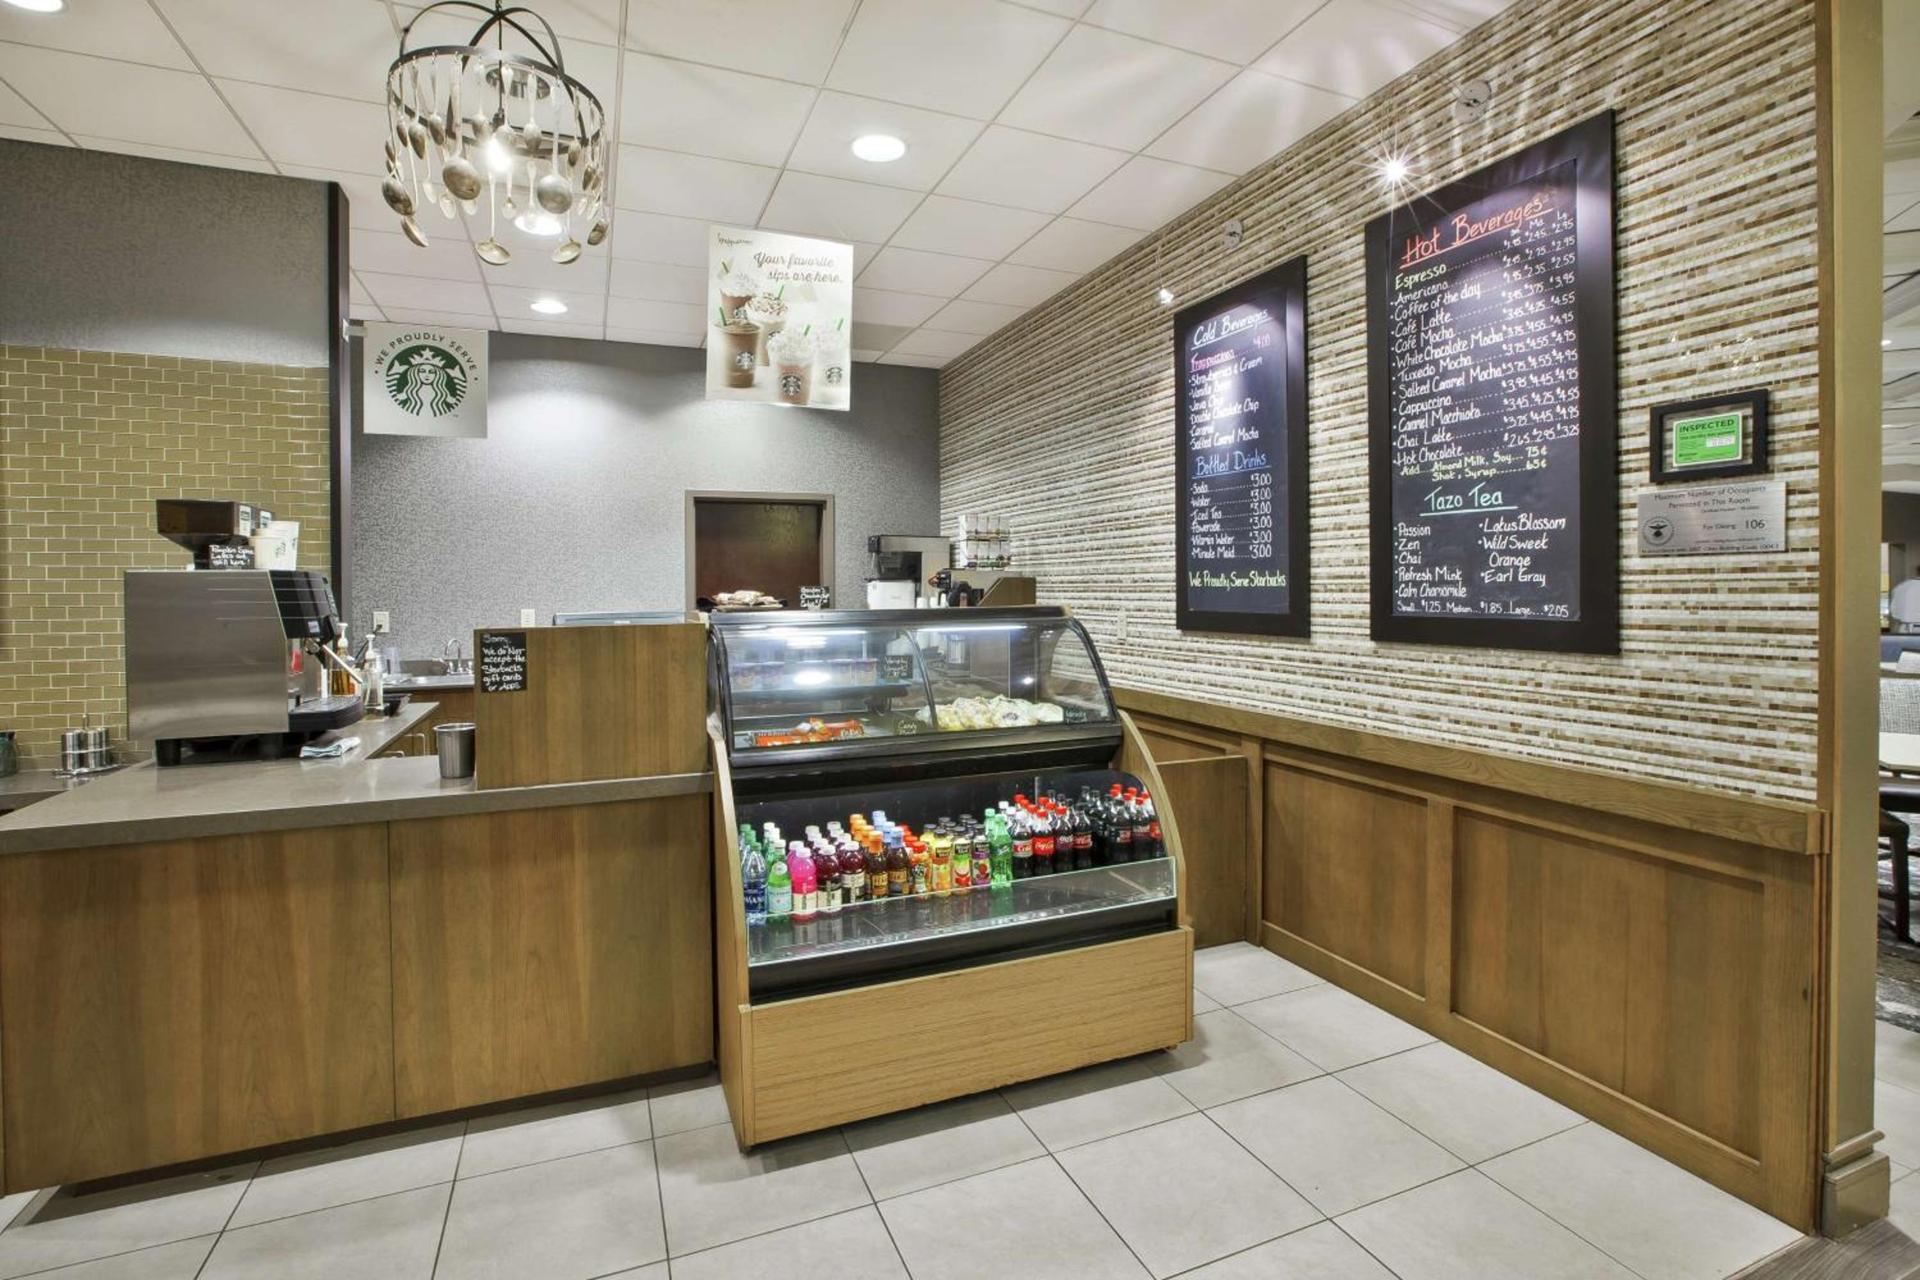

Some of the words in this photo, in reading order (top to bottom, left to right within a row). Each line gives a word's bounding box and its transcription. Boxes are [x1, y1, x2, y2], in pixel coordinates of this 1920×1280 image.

[1400, 227, 1441, 263] Hot
[1451, 196, 1544, 246] Beverages
[754, 251, 786, 268] Your
[787, 253, 835, 269] favorite
[793, 272, 812, 282] are
[1394, 264, 1447, 290] Espresso
[1394, 281, 1449, 306] Americano
[1394, 300, 1429, 321] Coffee
[1431, 294, 1442, 309] of
[1443, 291, 1459, 305] the
[1460, 282, 1480, 300] day
[1193, 320, 1217, 346] Cold
[1222, 308, 1269, 336] Beverages
[1421, 307, 1453, 331] Latte
[1420, 325, 1456, 347] Mocha
[375, 348, 389, 365] WE
[389, 332, 445, 349] PROUDLY
[449, 341, 478, 371] SERVE
[1396, 350, 1424, 368] White
[1424, 338, 1469, 360] Chocolate
[1470, 327, 1504, 349] Mocha
[1240, 356, 1263, 372] Cream
[1397, 363, 1436, 382] Tuxedo
[1440, 352, 1472, 373] Mocha
[1399, 380, 1430, 399] Salted
[1470, 361, 1502, 383] Mocha
[1191, 400, 1207, 411] Java
[1243, 397, 1259, 413] Chip
[1398, 395, 1452, 416] Cappuccino
[1431, 401, 1481, 426] Macchiato
[1238, 426, 1259, 442] Mocha
[1680, 419, 1735, 432] INSPECTED
[1397, 434, 1419, 449] Chai
[1424, 426, 1454, 445] Latte
[1196, 453, 1229, 476] Bottled
[1234, 448, 1267, 470] Drinks
[1395, 450, 1417, 466] Hot
[1419, 442, 1463, 463] Chocolate
[1400, 464, 1420, 476] Add
[1432, 459, 1462, 472] Almond
[1492, 451, 1512, 464] Soy
[1464, 468, 1497, 480] Syrup
[1424, 485, 1463, 511] Tazo
[1467, 481, 1503, 507] Tea
[1211, 506, 1222, 519] Tea
[1398, 522, 1431, 537] Passion
[1483, 518, 1518, 533] Lotus
[1518, 513, 1567, 531] Blossom
[1745, 520, 1766, 530] 106
[1398, 538, 1421, 551] Zen
[1482, 534, 1508, 550] Wild
[1508, 533, 1549, 550] Sweet
[1218, 546, 1235, 559] Maid
[1398, 551, 1422, 565] Chai
[1489, 551, 1531, 568] Orange
[1189, 571, 1202, 587] We
[1203, 570, 1231, 591] Proudly
[1231, 571, 1250, 587] Serve
[1250, 569, 1287, 588] Starbucks
[1398, 566, 1433, 582] Refresh
[1435, 565, 1463, 581] Mint
[1484, 567, 1513, 584] Earl
[1517, 569, 1546, 588] Gray
[1398, 583, 1418, 598] Calm
[1419, 582, 1468, 598] Chamomile
[1397, 600, 1416, 613] Small
[1446, 601, 1473, 614] Medium
[1509, 601, 1532, 618] Large
[482, 647, 496, 656] We
[497, 647, 507, 655] do
[483, 656, 512, 664] accept
[513, 655, 526, 663] the
